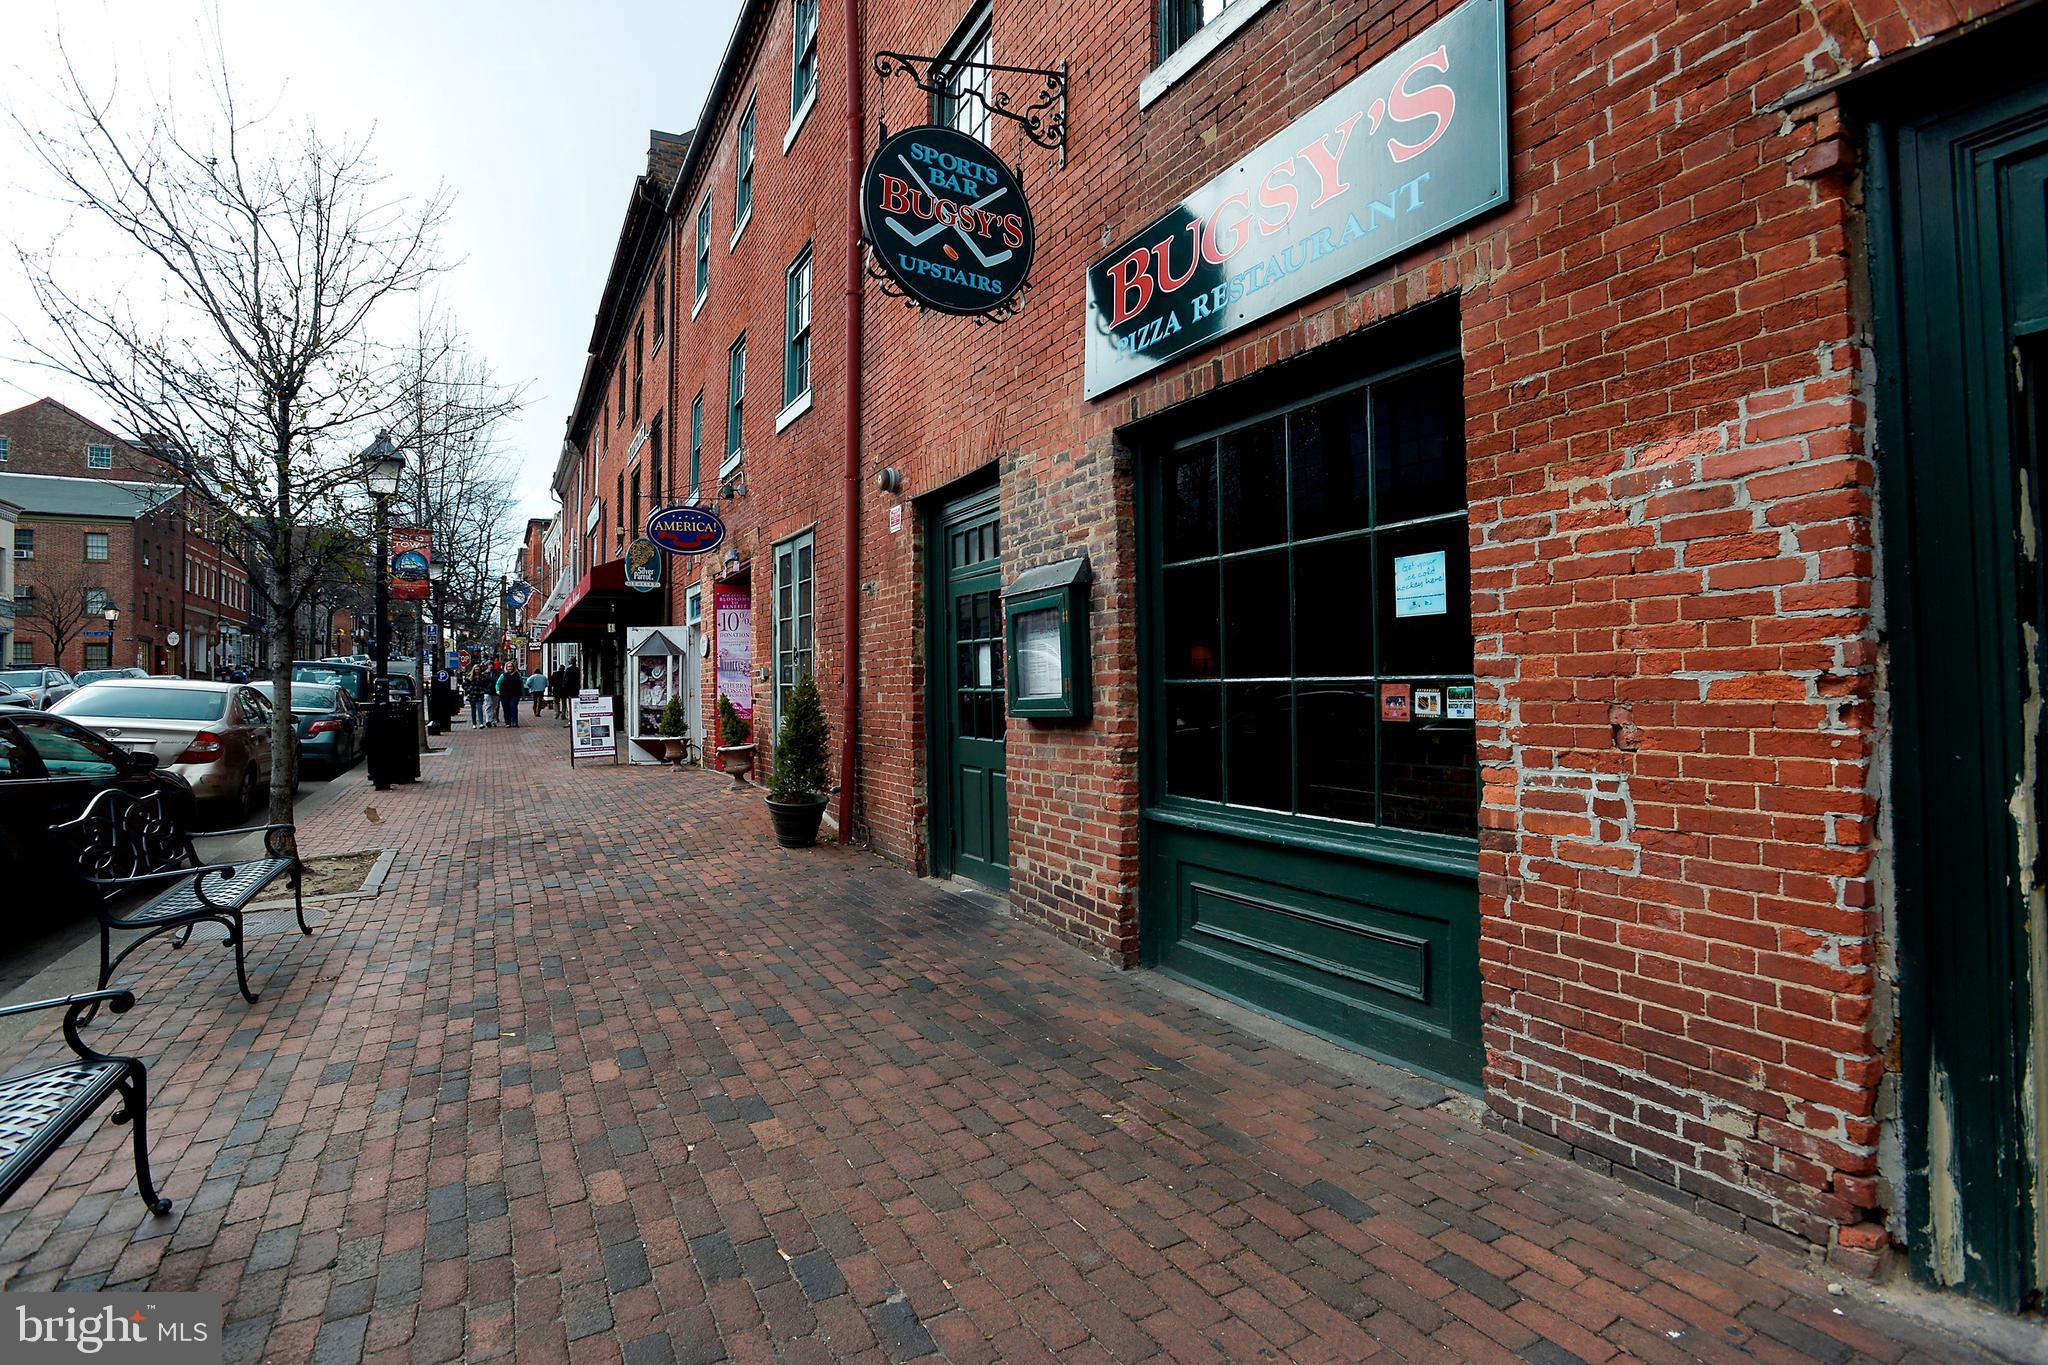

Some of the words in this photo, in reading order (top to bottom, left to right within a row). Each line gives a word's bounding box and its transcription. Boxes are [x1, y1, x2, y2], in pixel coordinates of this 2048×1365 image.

[910, 142, 999, 185] SPORTS
[928, 166, 981, 199] BAR
[1106, 44, 1456, 331] BUGSY'S
[878, 173, 1025, 249] BUGSY'S
[898, 253, 1003, 294] UPSTAIRS
[1115, 309, 1183, 363] PIZZA
[1191, 172, 1432, 325] RESTAURANT
[654, 521, 718, 533] AMERICA!
[394, 541, 430, 549] TOWN
[637, 566, 655, 575] Silver
[1396, 581, 1424, 592] hockey
[720, 612, 750, 632] 10%
